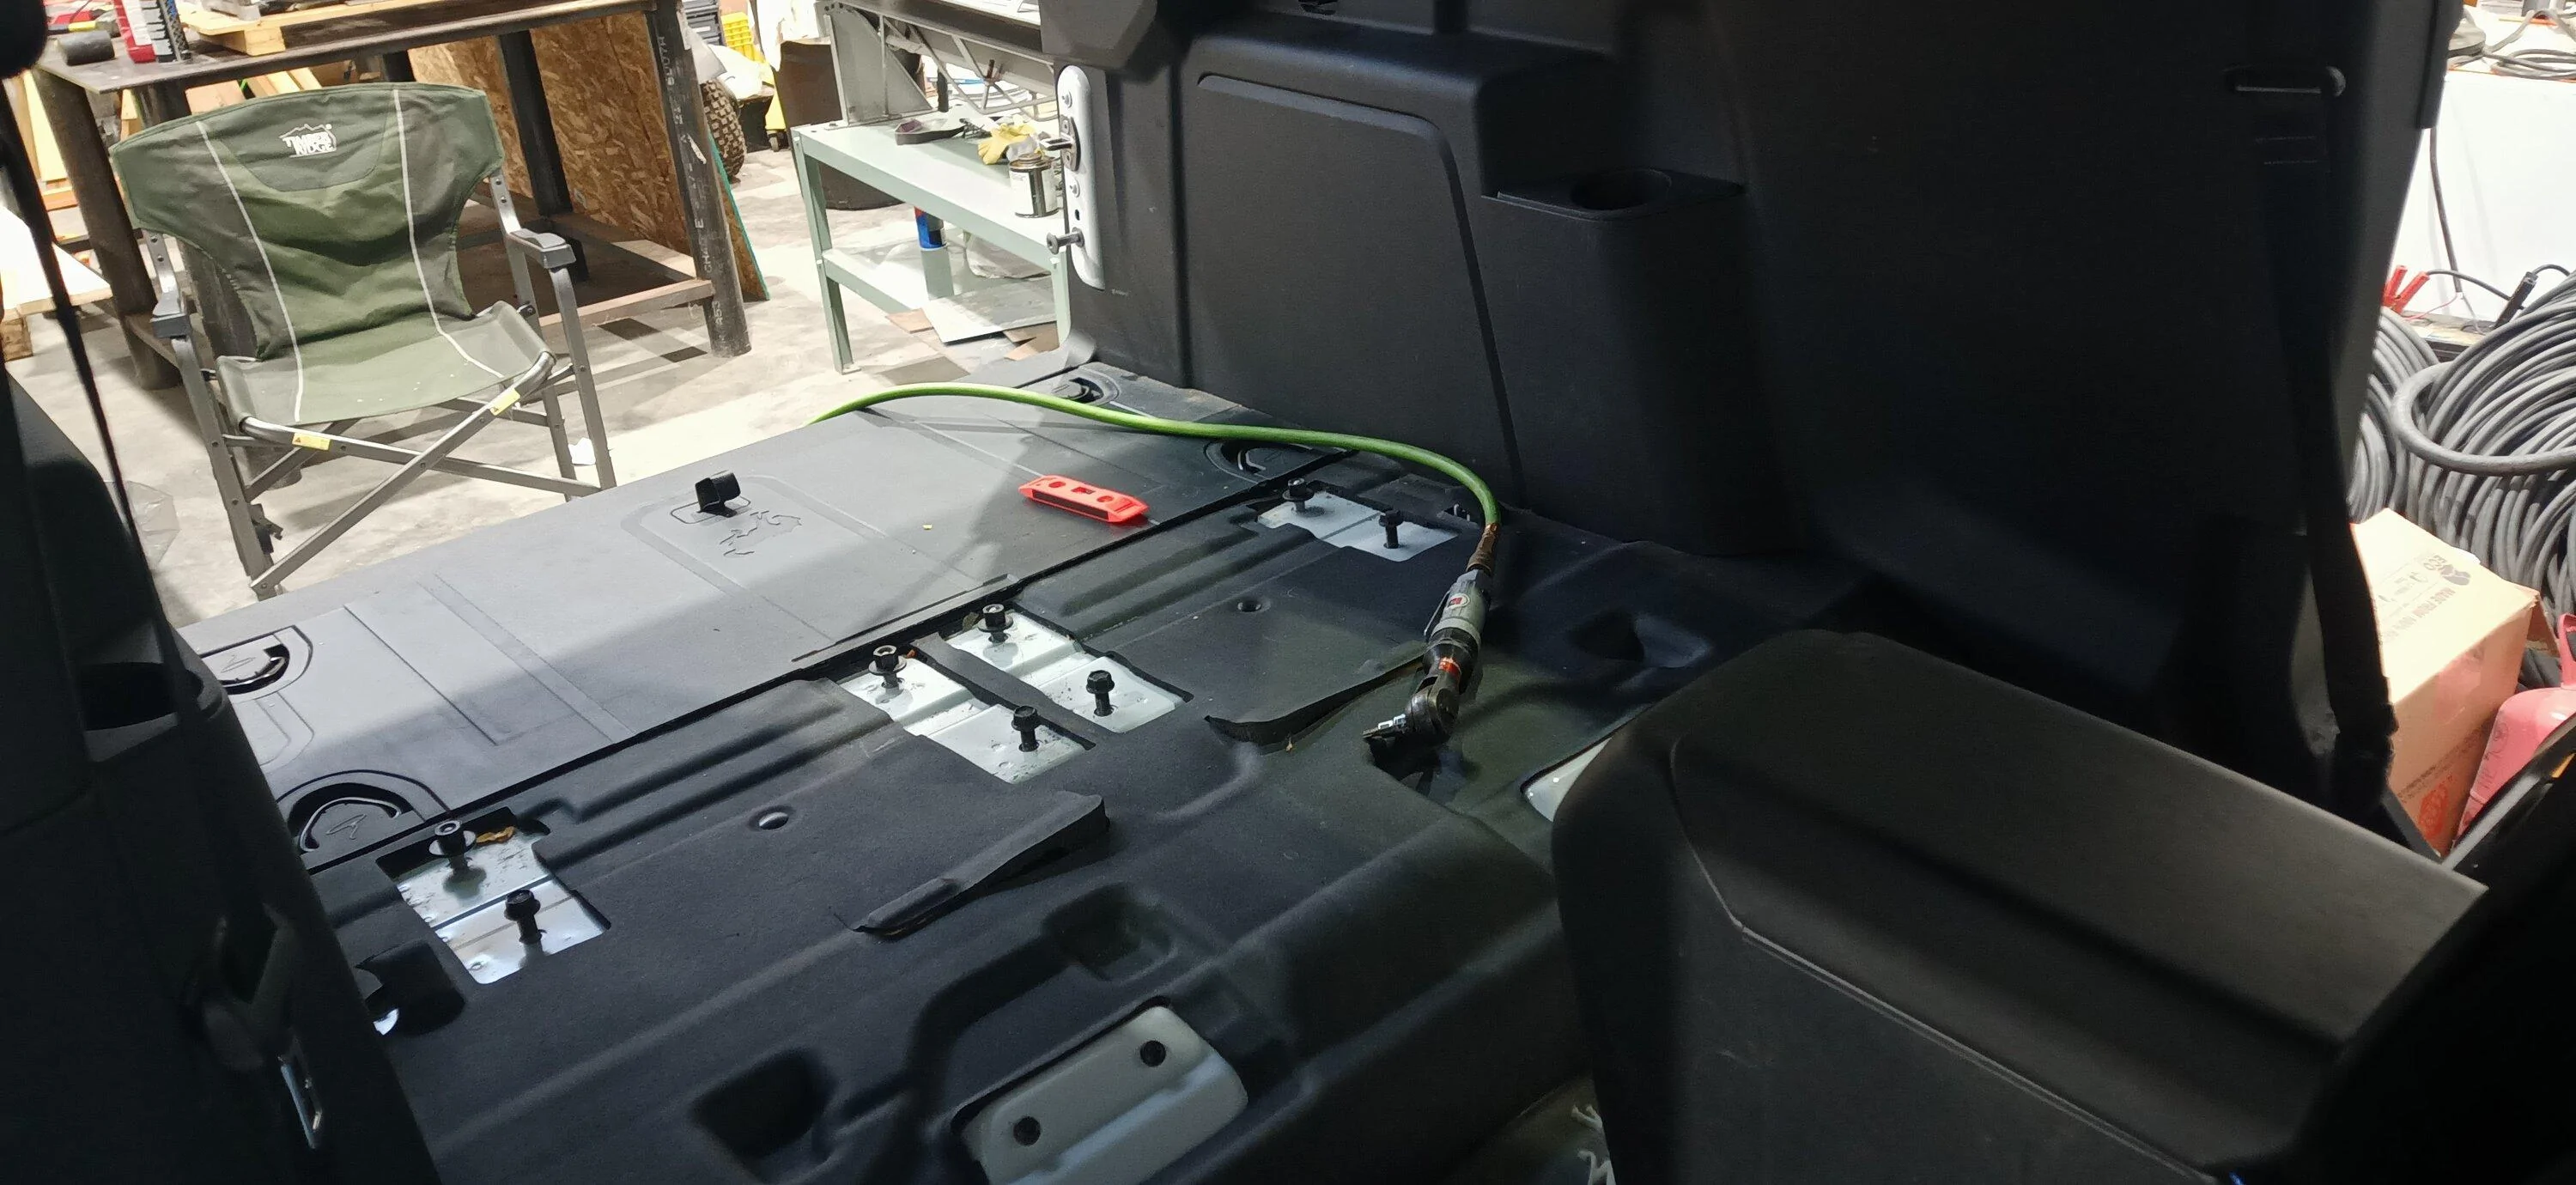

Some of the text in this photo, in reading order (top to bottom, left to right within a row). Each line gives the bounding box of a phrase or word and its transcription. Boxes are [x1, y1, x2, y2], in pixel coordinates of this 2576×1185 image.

[283, 131, 331, 148] TIMBER
[294, 142, 334, 155] RIDGE
[2423, 555, 2447, 571] ECO
